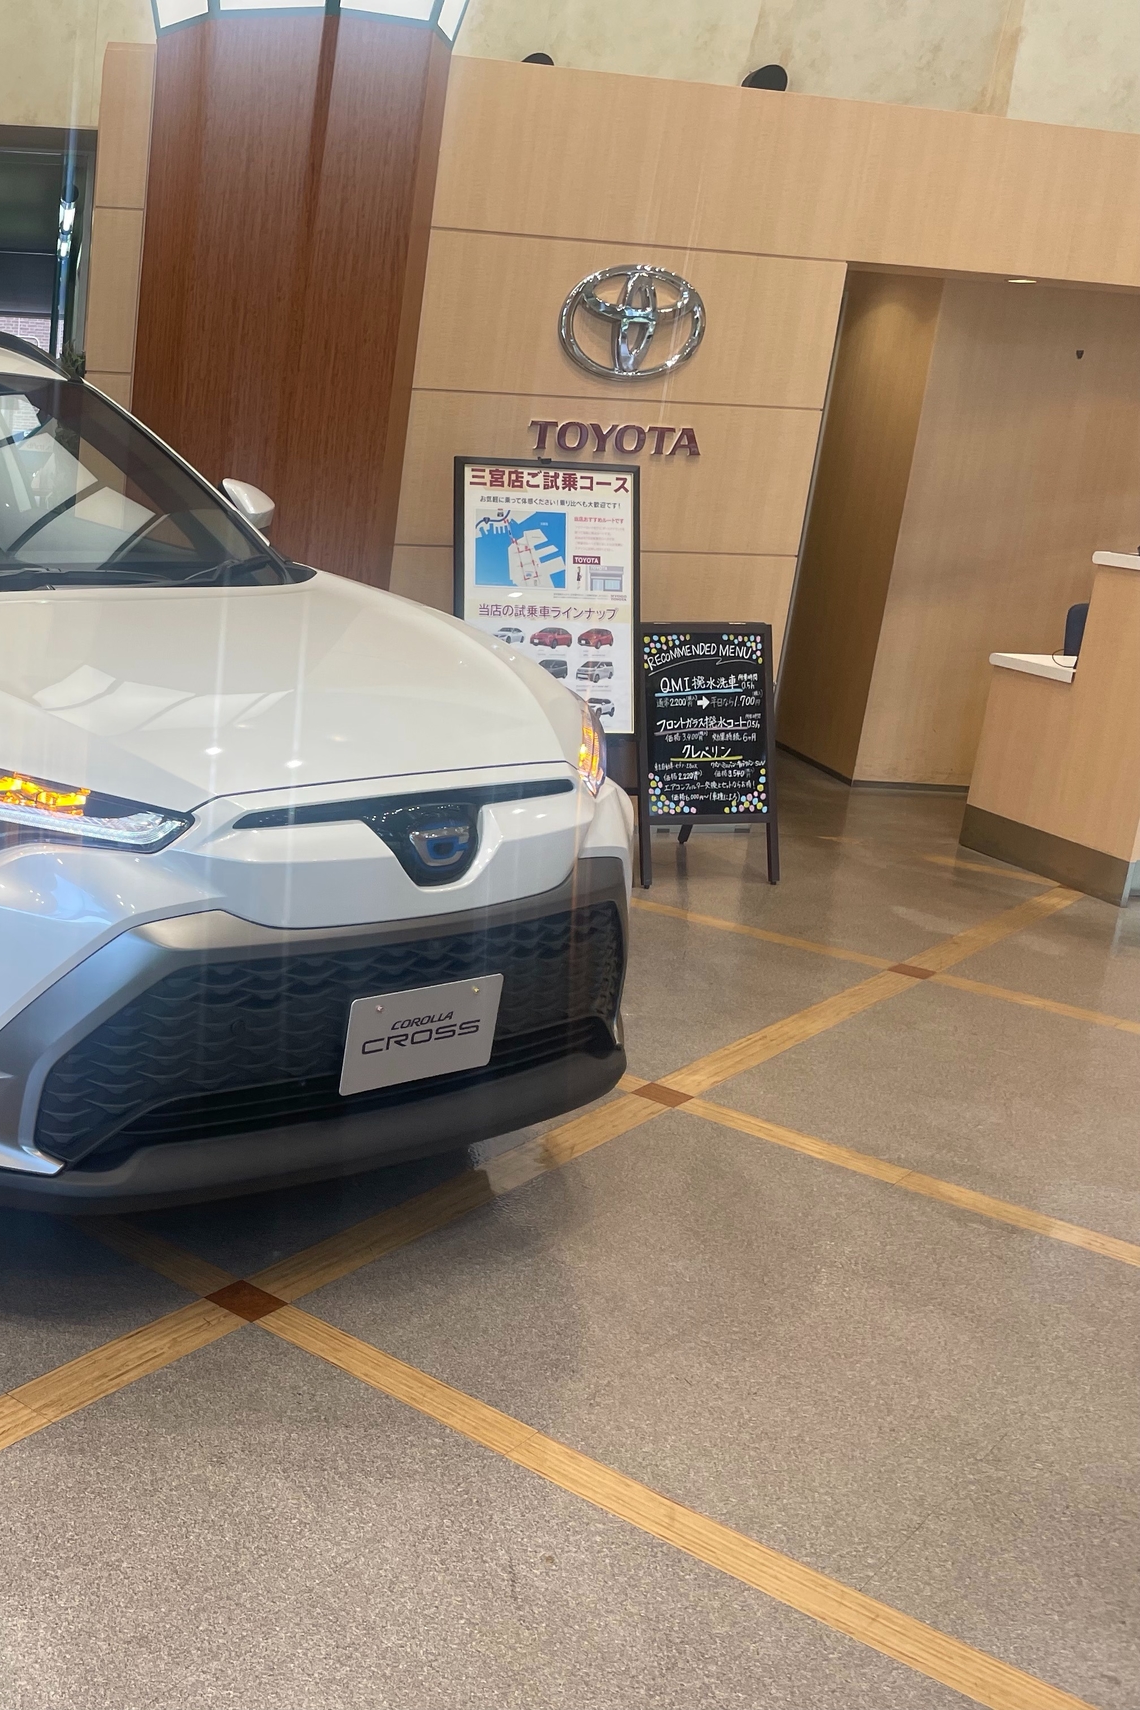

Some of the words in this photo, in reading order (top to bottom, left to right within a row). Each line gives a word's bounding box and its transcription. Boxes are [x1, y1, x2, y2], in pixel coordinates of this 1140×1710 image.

[528, 420, 700, 456] TOYOTA
[469, 468, 630, 494] 三宮店ご試乗コース
[574, 556, 599, 564] TOYOTA
[478, 603, 618, 621] 当店の試乗車ラインナップ
[647, 643, 717, 670] RECOMMENDED
[719, 645, 752, 659] MENU
[682, 744, 731, 759] クレベリン
[391, 1010, 454, 1031] COROLLA
[362, 1019, 481, 1055] CROSS
